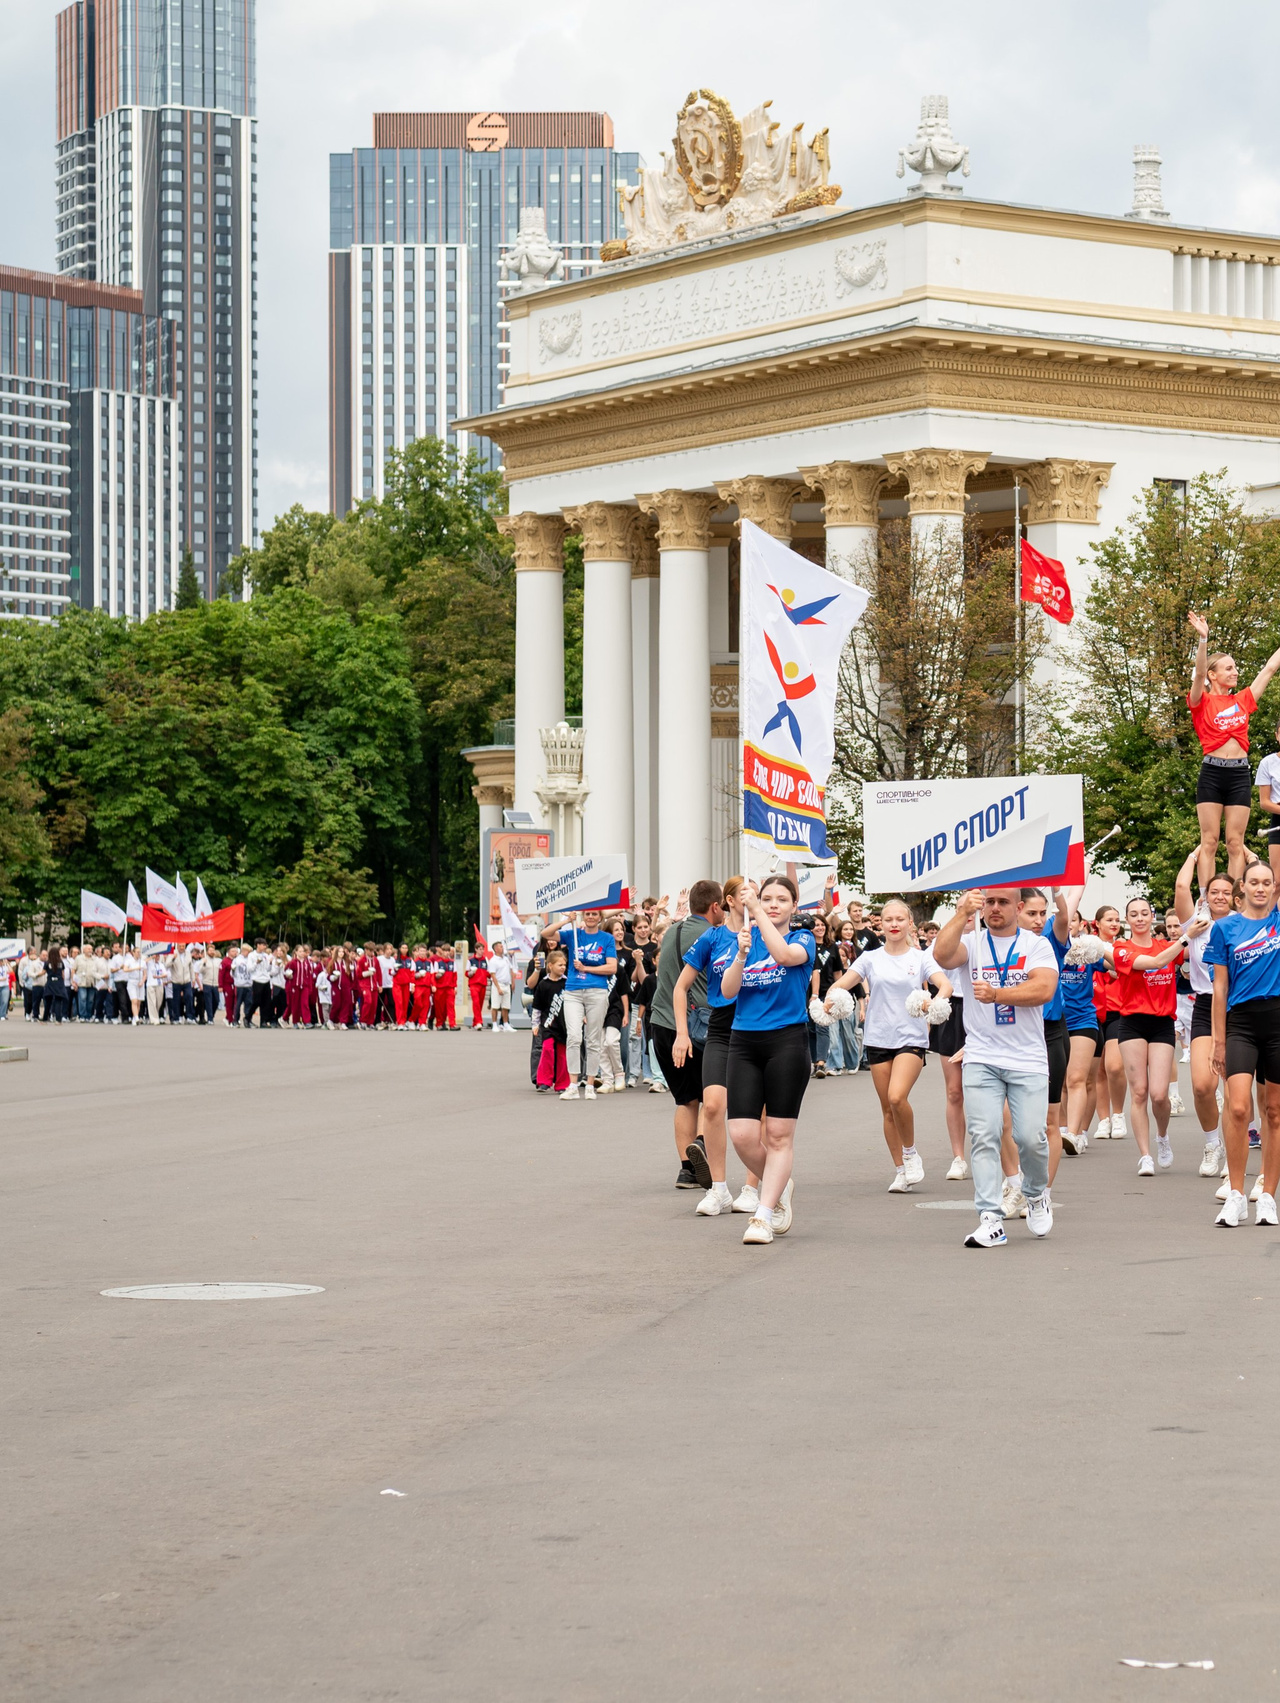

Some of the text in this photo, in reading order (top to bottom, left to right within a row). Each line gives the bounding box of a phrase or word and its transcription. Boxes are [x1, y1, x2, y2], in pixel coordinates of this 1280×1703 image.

[771, 769, 795, 801] ЧИР
[876, 789, 932, 799] СПОРТИВНОЕ
[901, 785, 1029, 881] ЧИР СПОРТ
[535, 859, 593, 900] АКРОБАТИЧЕСКИЙ
[536, 881, 577, 911] РОК-Н-РОЛЛ
[742, 968, 787, 981] ПОРТИВНОЕ
[972, 971, 1029, 981] СОРТНОЕ
